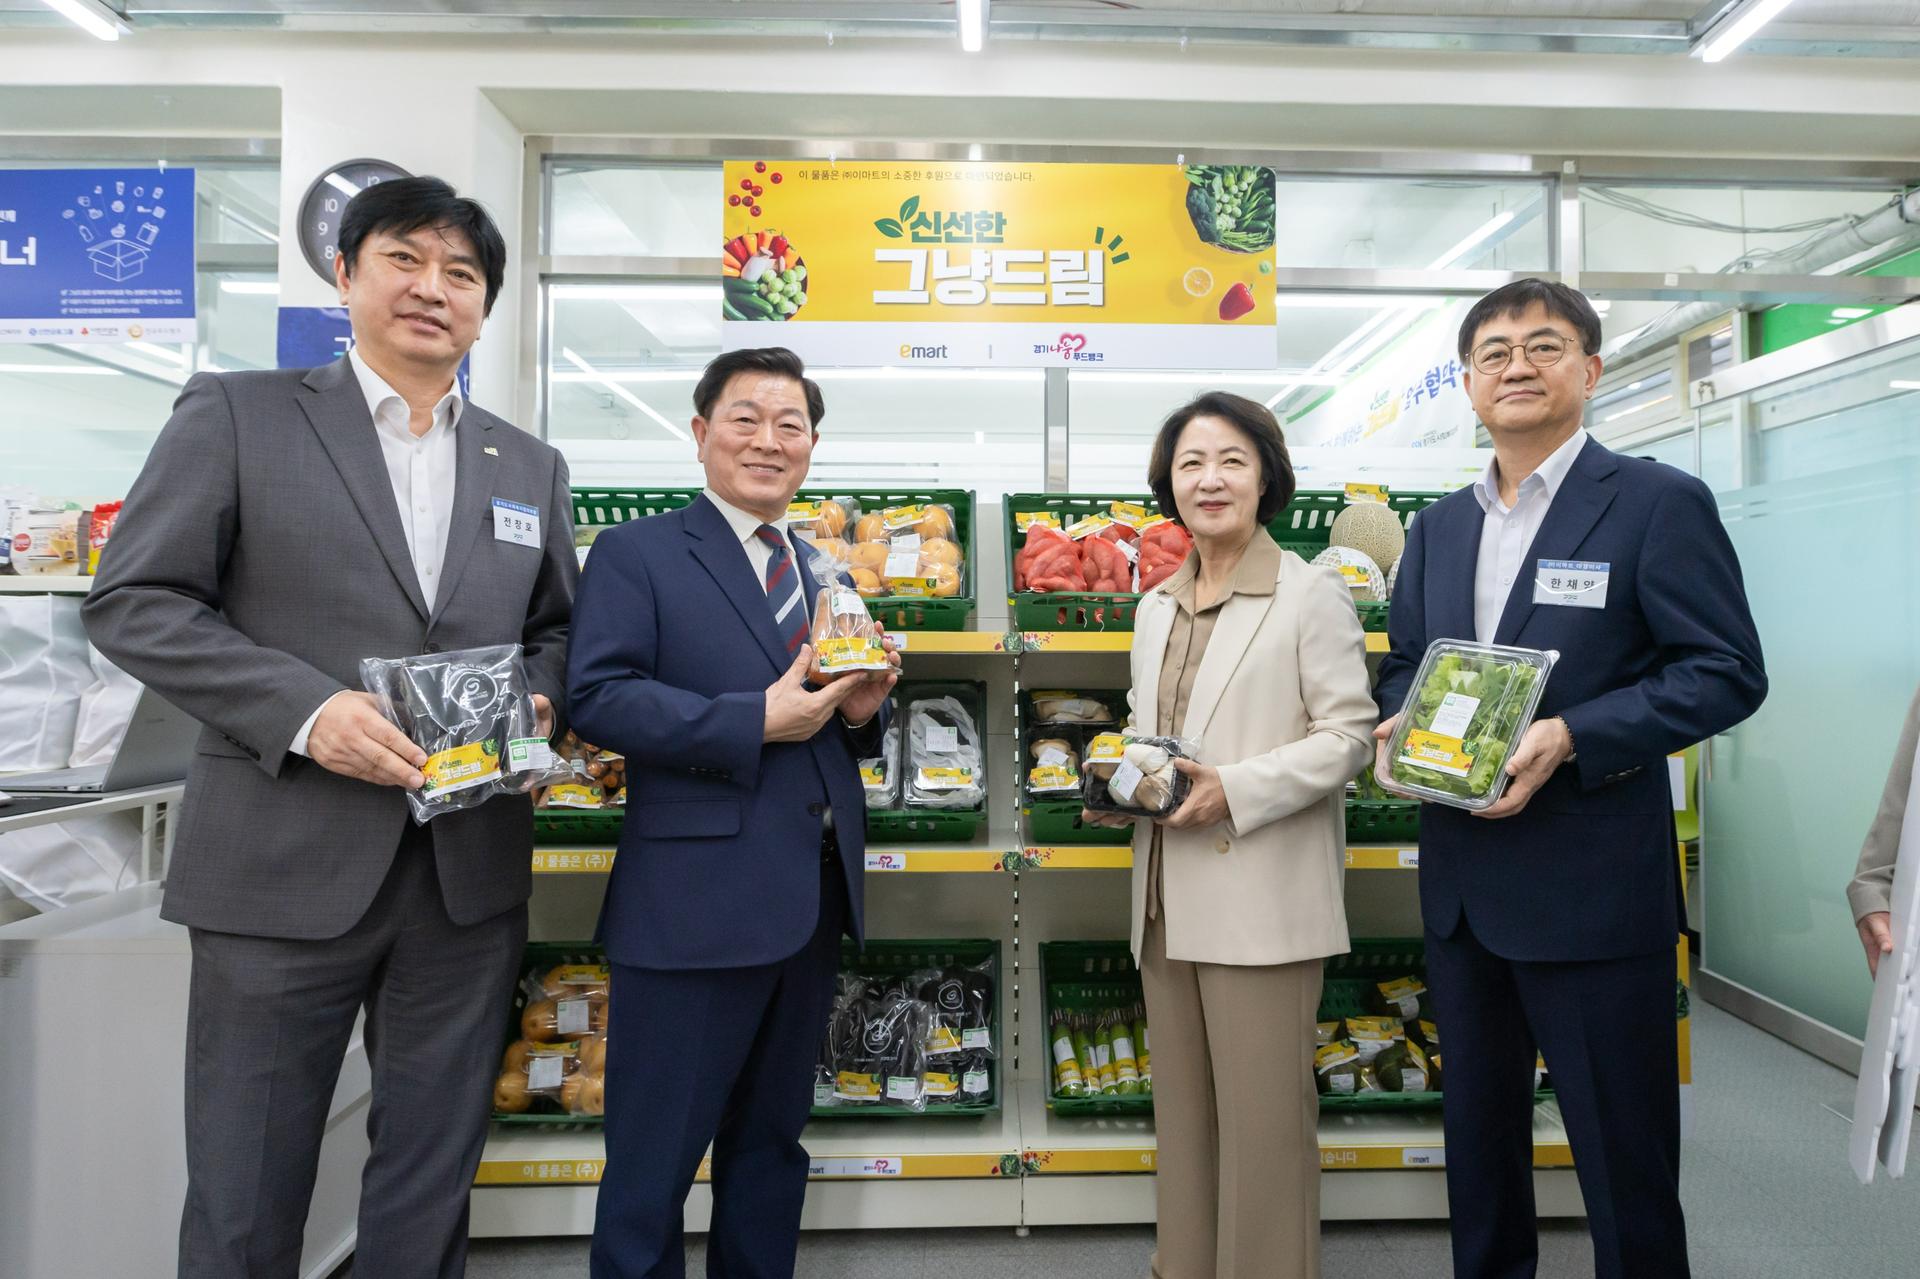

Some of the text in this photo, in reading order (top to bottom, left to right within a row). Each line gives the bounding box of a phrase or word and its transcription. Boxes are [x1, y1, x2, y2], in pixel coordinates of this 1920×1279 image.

[798, 170, 809, 181] 이
[811, 170, 840, 181] 물품은
[893, 170, 921, 181] 소중한
[925, 170, 962, 182] 후원으로
[324, 198, 339, 213] 10
[318, 221, 329, 236] 9
[909, 210, 1008, 244] 신선한
[324, 244, 336, 260] 8
[873, 248, 1105, 307] 그냥드림
[900, 344, 948, 359] emart
[548, 854, 581, 869] 물품은
[584, 854, 607, 869] (주)
[1320, 1151, 1358, 1165] 습니다
[523, 1162, 599, 1178] 이 물품은 (주)
